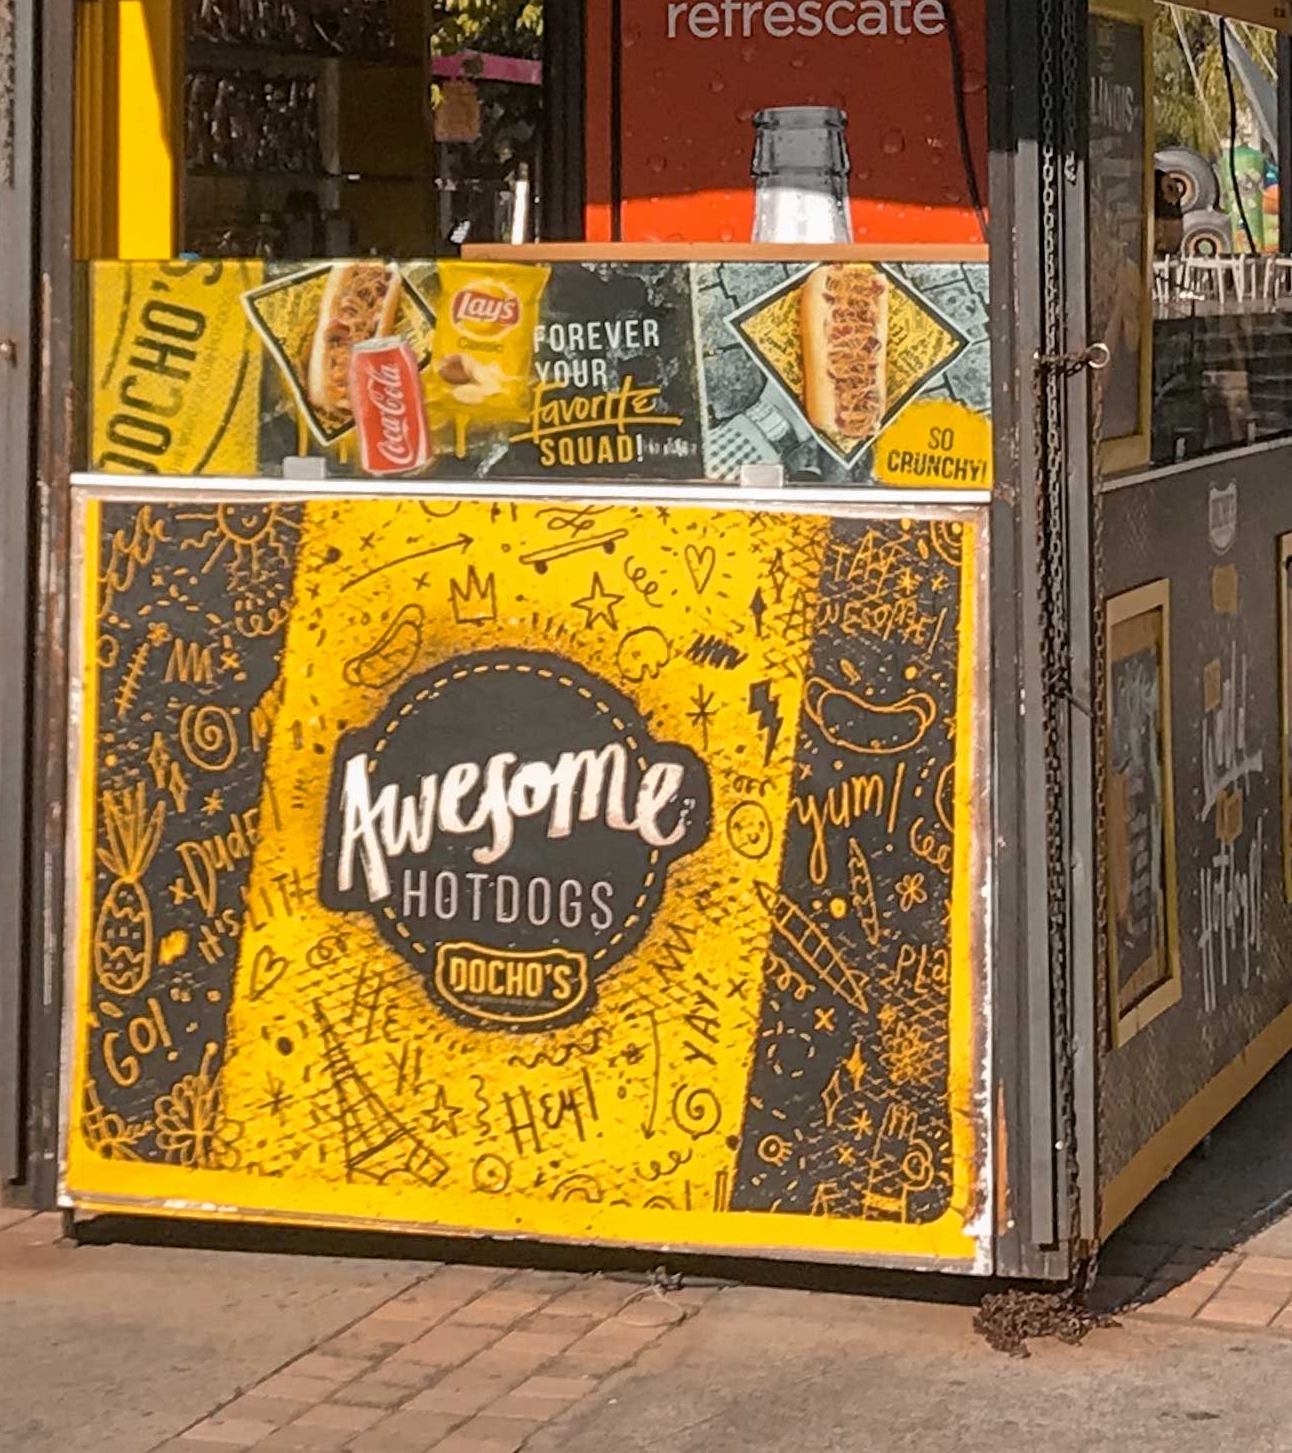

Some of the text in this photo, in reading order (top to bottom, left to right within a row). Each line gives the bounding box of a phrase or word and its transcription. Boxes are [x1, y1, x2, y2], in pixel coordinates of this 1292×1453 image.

[533, 319, 660, 353] FOREVER
[535, 358, 608, 388] YOUR
[540, 434, 644, 466] SQUAD!
[928, 426, 955, 451] SO
[887, 453, 987, 483] CRUNCHY!
[402, 869, 614, 931] HOTDOGS
[449, 957, 573, 999] DOCHO'S
